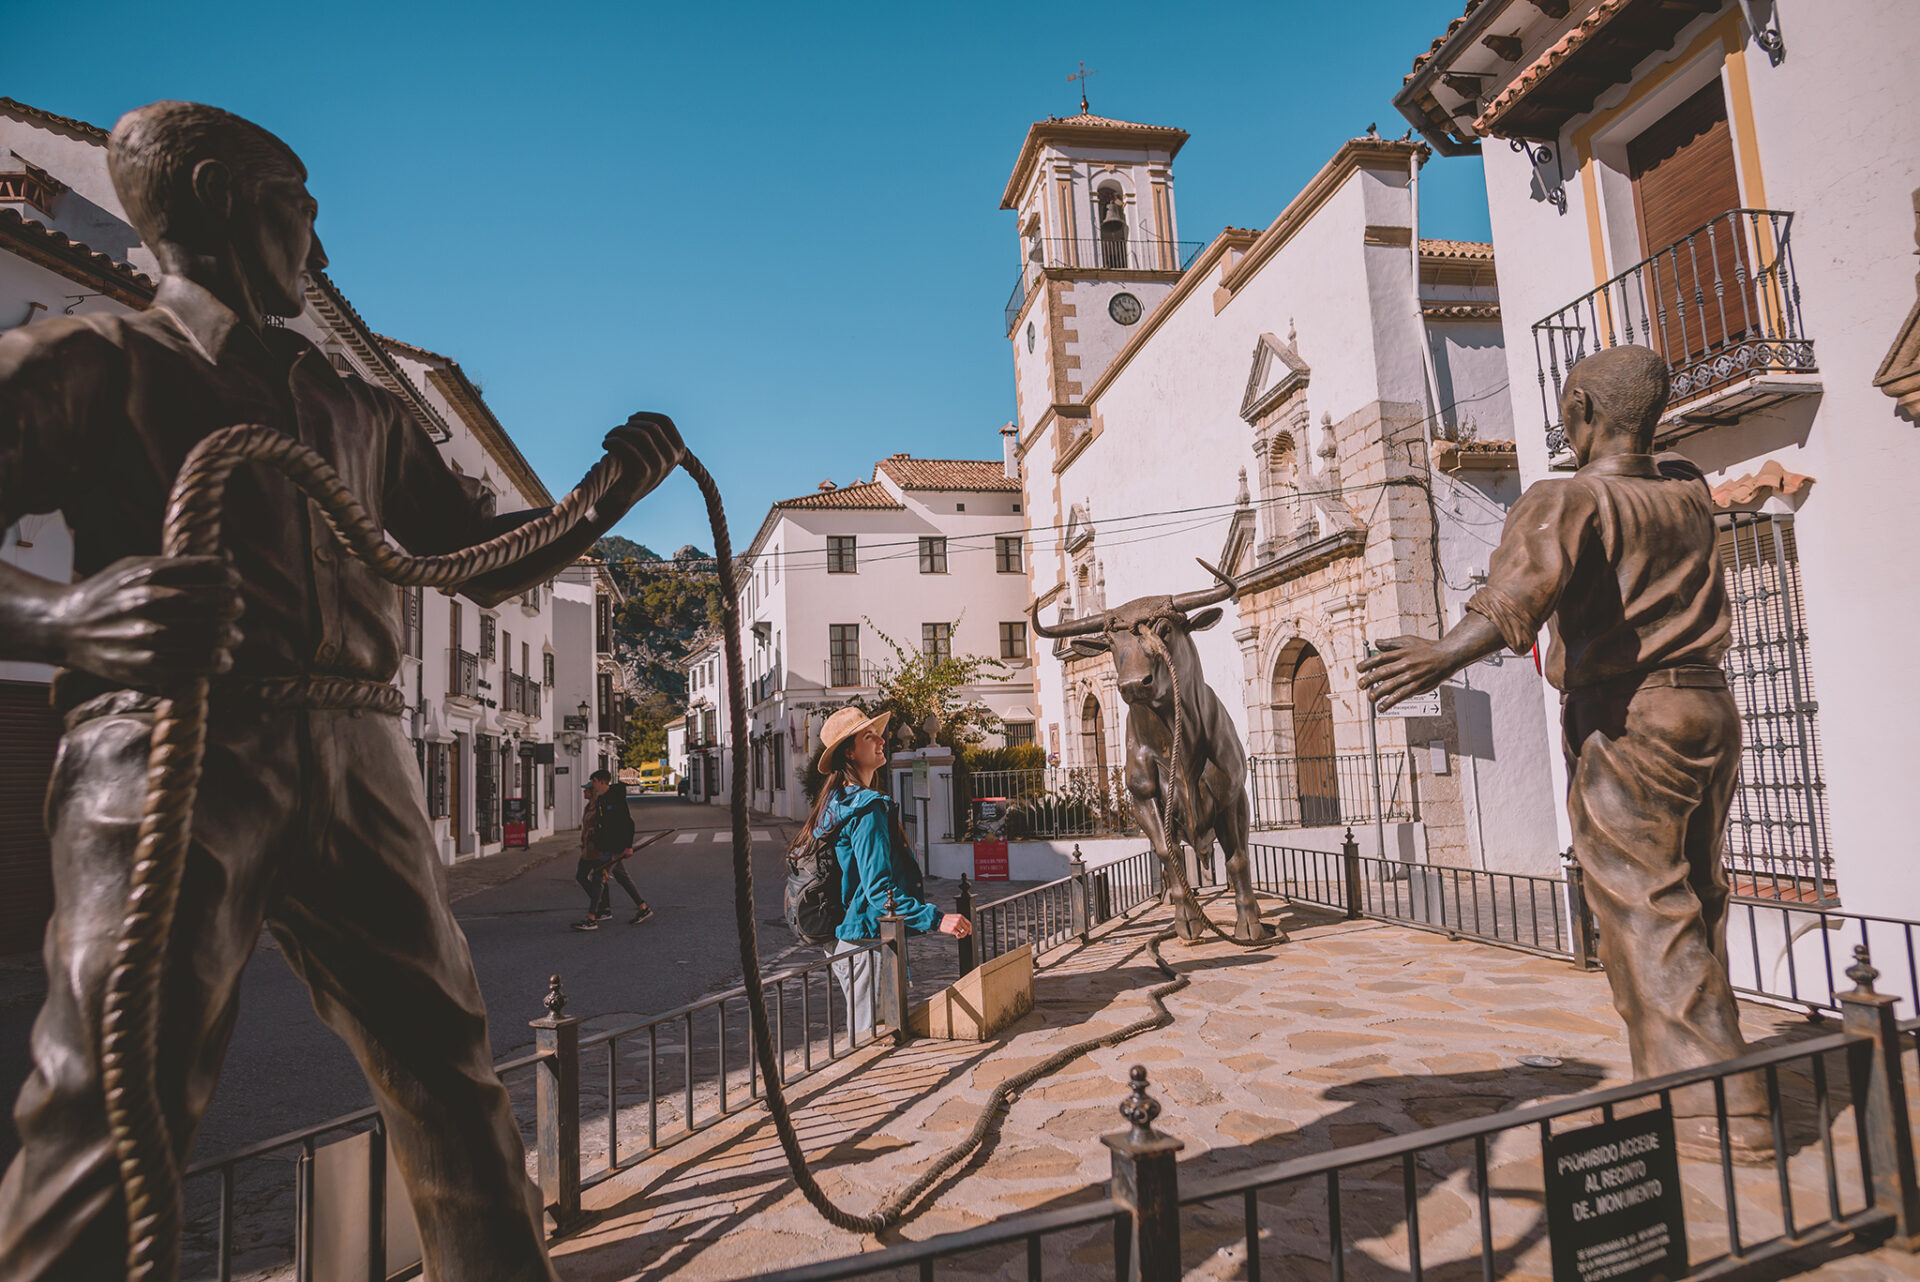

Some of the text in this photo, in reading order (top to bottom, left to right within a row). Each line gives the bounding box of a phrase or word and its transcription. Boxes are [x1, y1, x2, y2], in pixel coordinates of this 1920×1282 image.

[1558, 1145, 1618, 1176] PROHIBIDO
[1585, 1160, 1647, 1193] AL RECINTO
[1596, 1179, 1662, 1215] MONUMENTO
